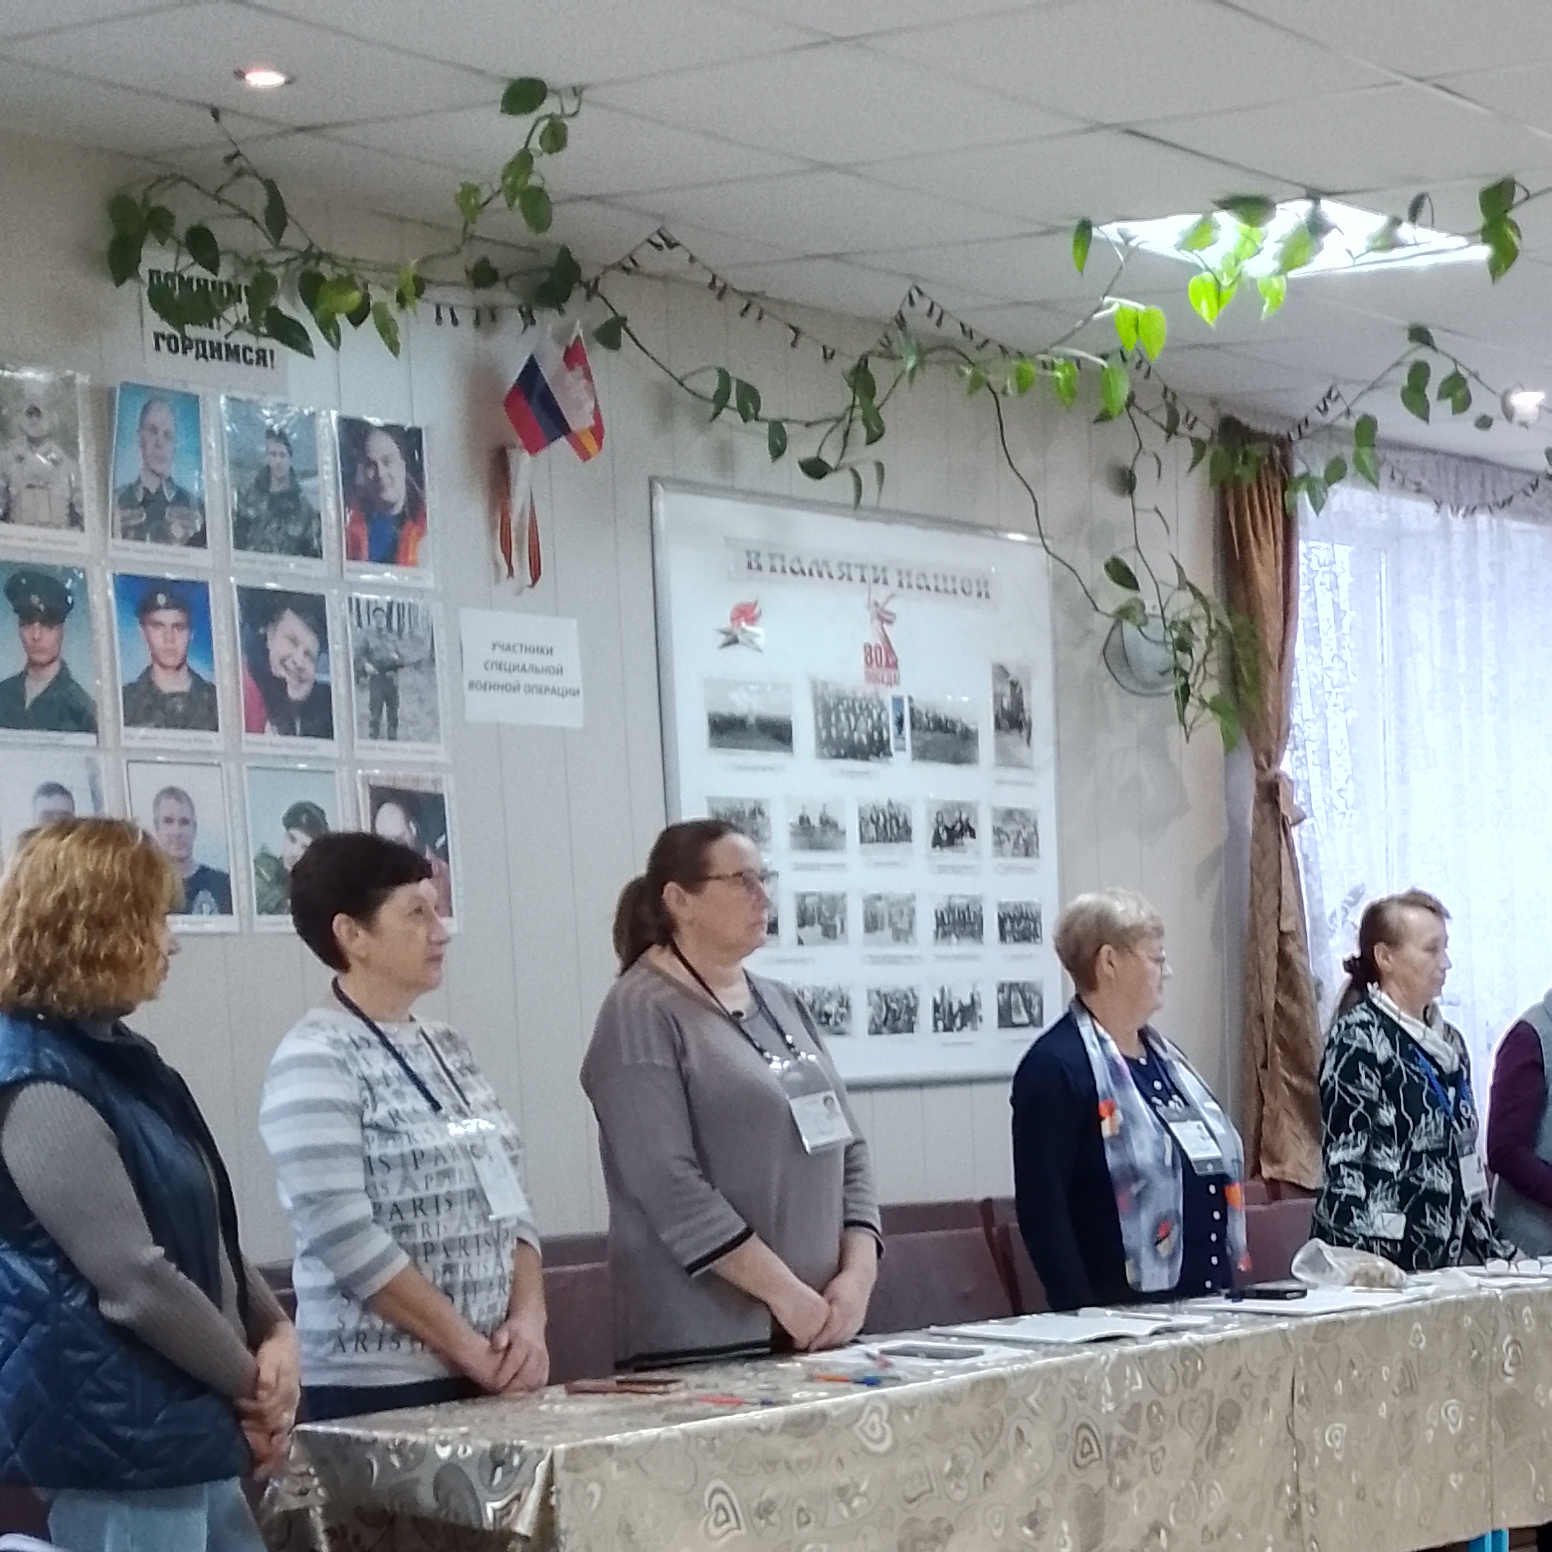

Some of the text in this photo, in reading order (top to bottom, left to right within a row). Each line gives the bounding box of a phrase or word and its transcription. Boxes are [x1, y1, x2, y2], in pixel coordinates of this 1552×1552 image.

[153, 331, 275, 369] ГОРДИМСЯ!
[768, 552, 890, 586] ПАМЯТИ
[491, 641, 554, 656] УЧАСТНИКИ
[863, 641, 883, 668] 80
[484, 659, 563, 676] СПЕЦИАЛЬНОЙ
[468, 680, 580, 700] ВОЕННОЙ ОПЕРАЦИИ
